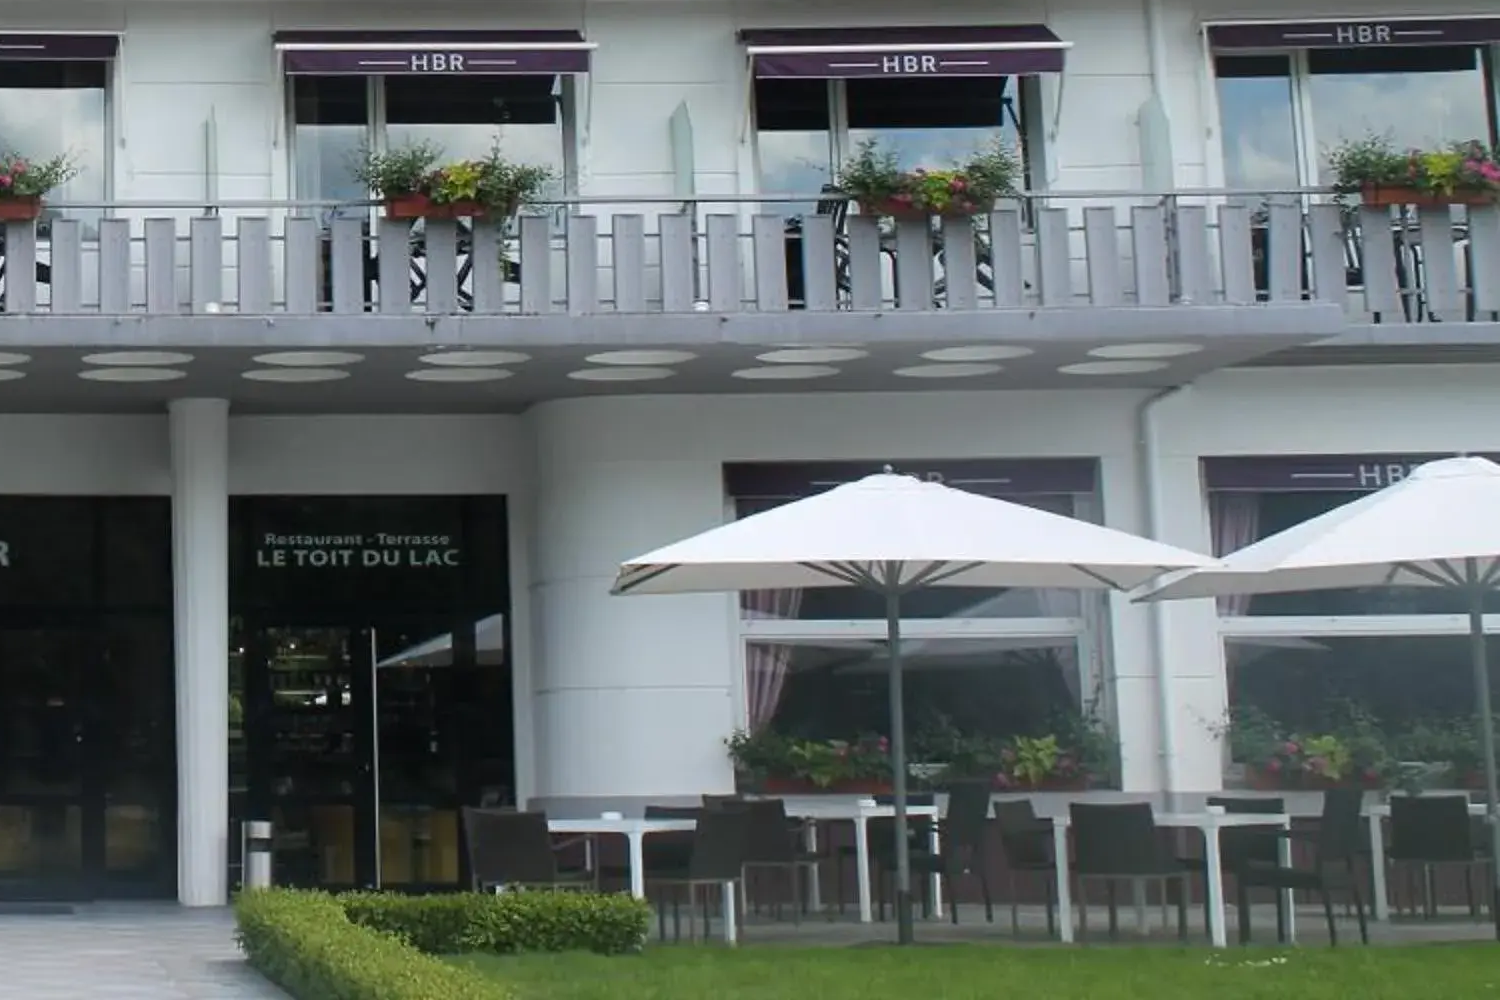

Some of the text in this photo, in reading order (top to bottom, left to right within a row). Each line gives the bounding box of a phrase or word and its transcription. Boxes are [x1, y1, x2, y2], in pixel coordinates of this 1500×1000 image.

[1336, 25, 1391, 43] HBR
[411, 53, 464, 71] HBR
[883, 55, 936, 73] HBR
[1359, 454, 1421, 487] HB
[264, 533, 363, 546] Restaurant
[378, 533, 450, 546] Terrasse
[256, 550, 459, 567] LE TOIT DU LAC
